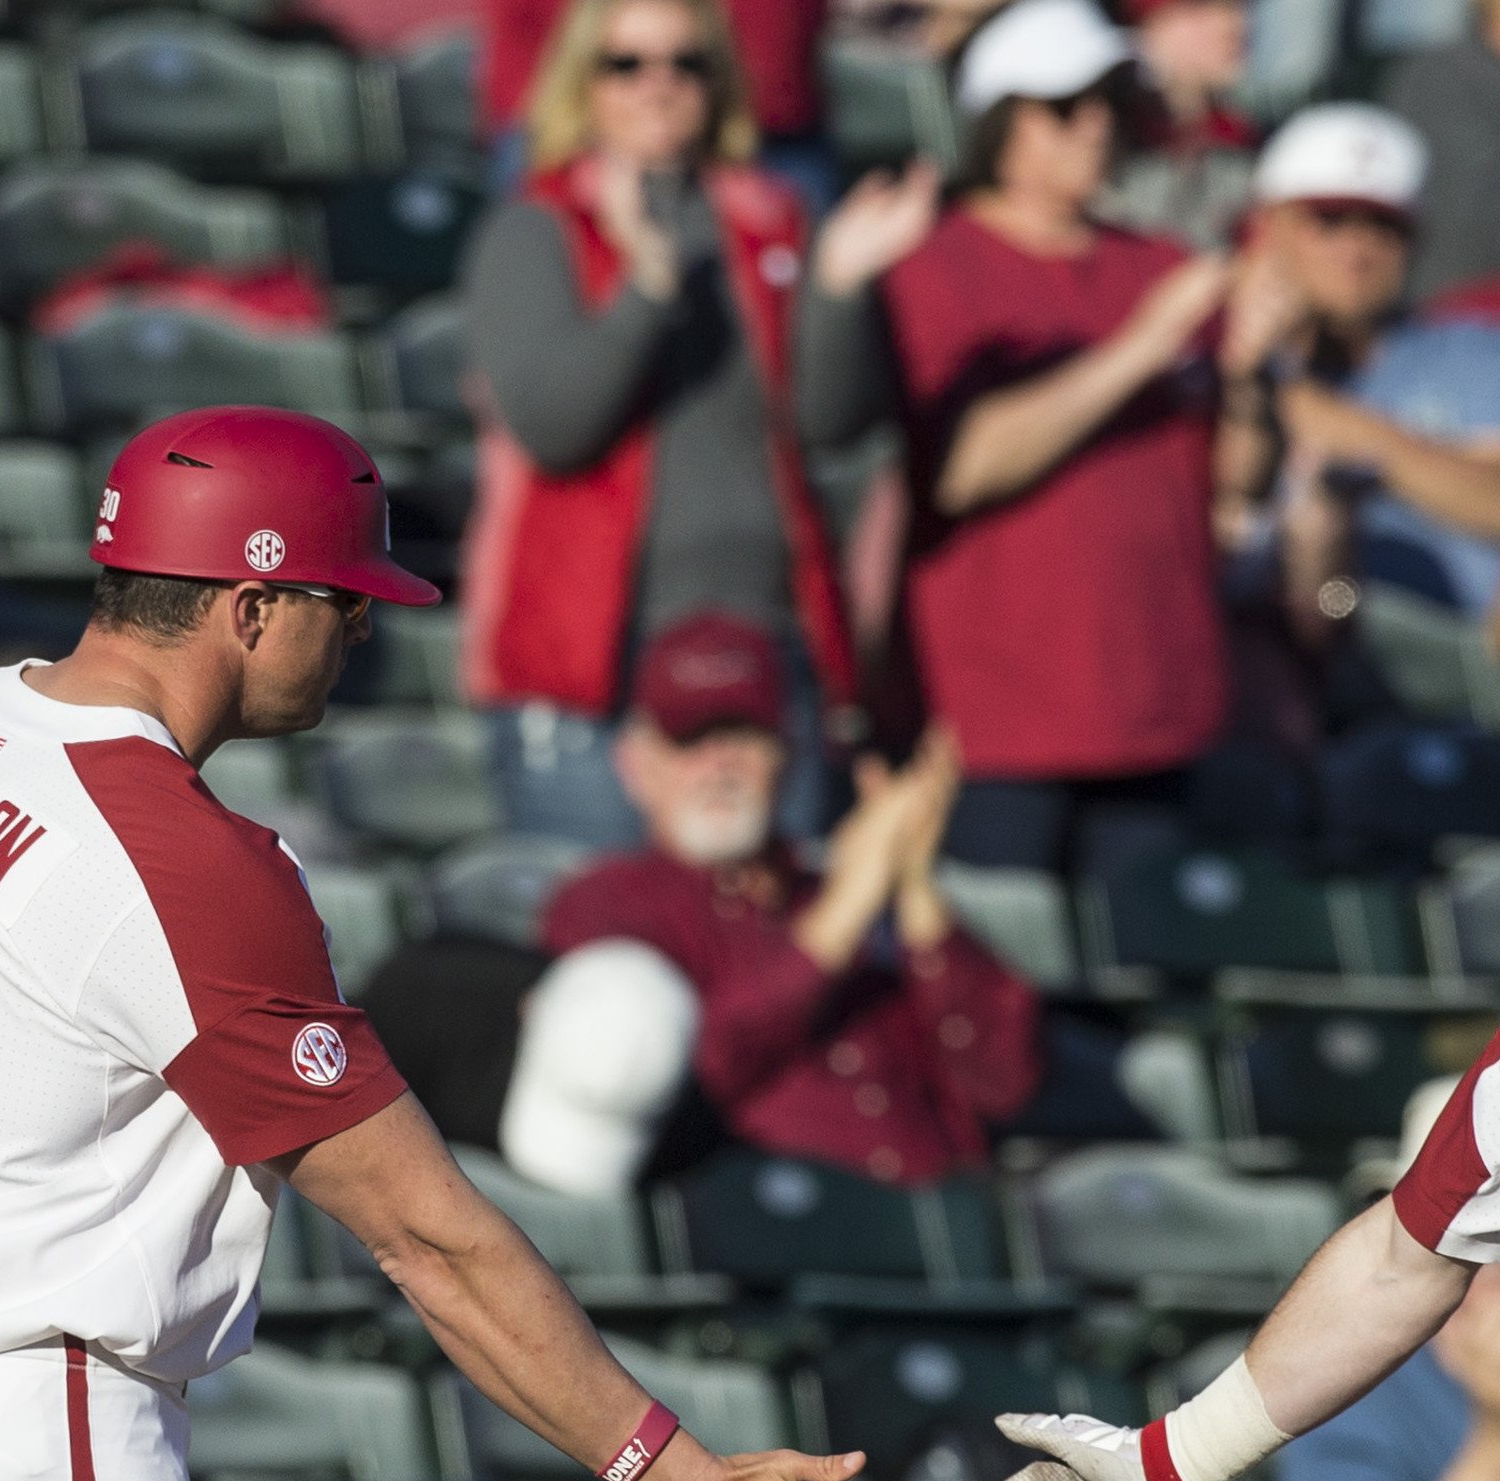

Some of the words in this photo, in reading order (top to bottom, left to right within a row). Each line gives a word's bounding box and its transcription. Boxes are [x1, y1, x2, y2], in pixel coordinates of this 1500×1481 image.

[99, 488, 121, 522] 30
[248, 532, 282, 568] SEC
[296, 1027, 342, 1082] SEC
[606, 1444, 643, 1481] ONE
